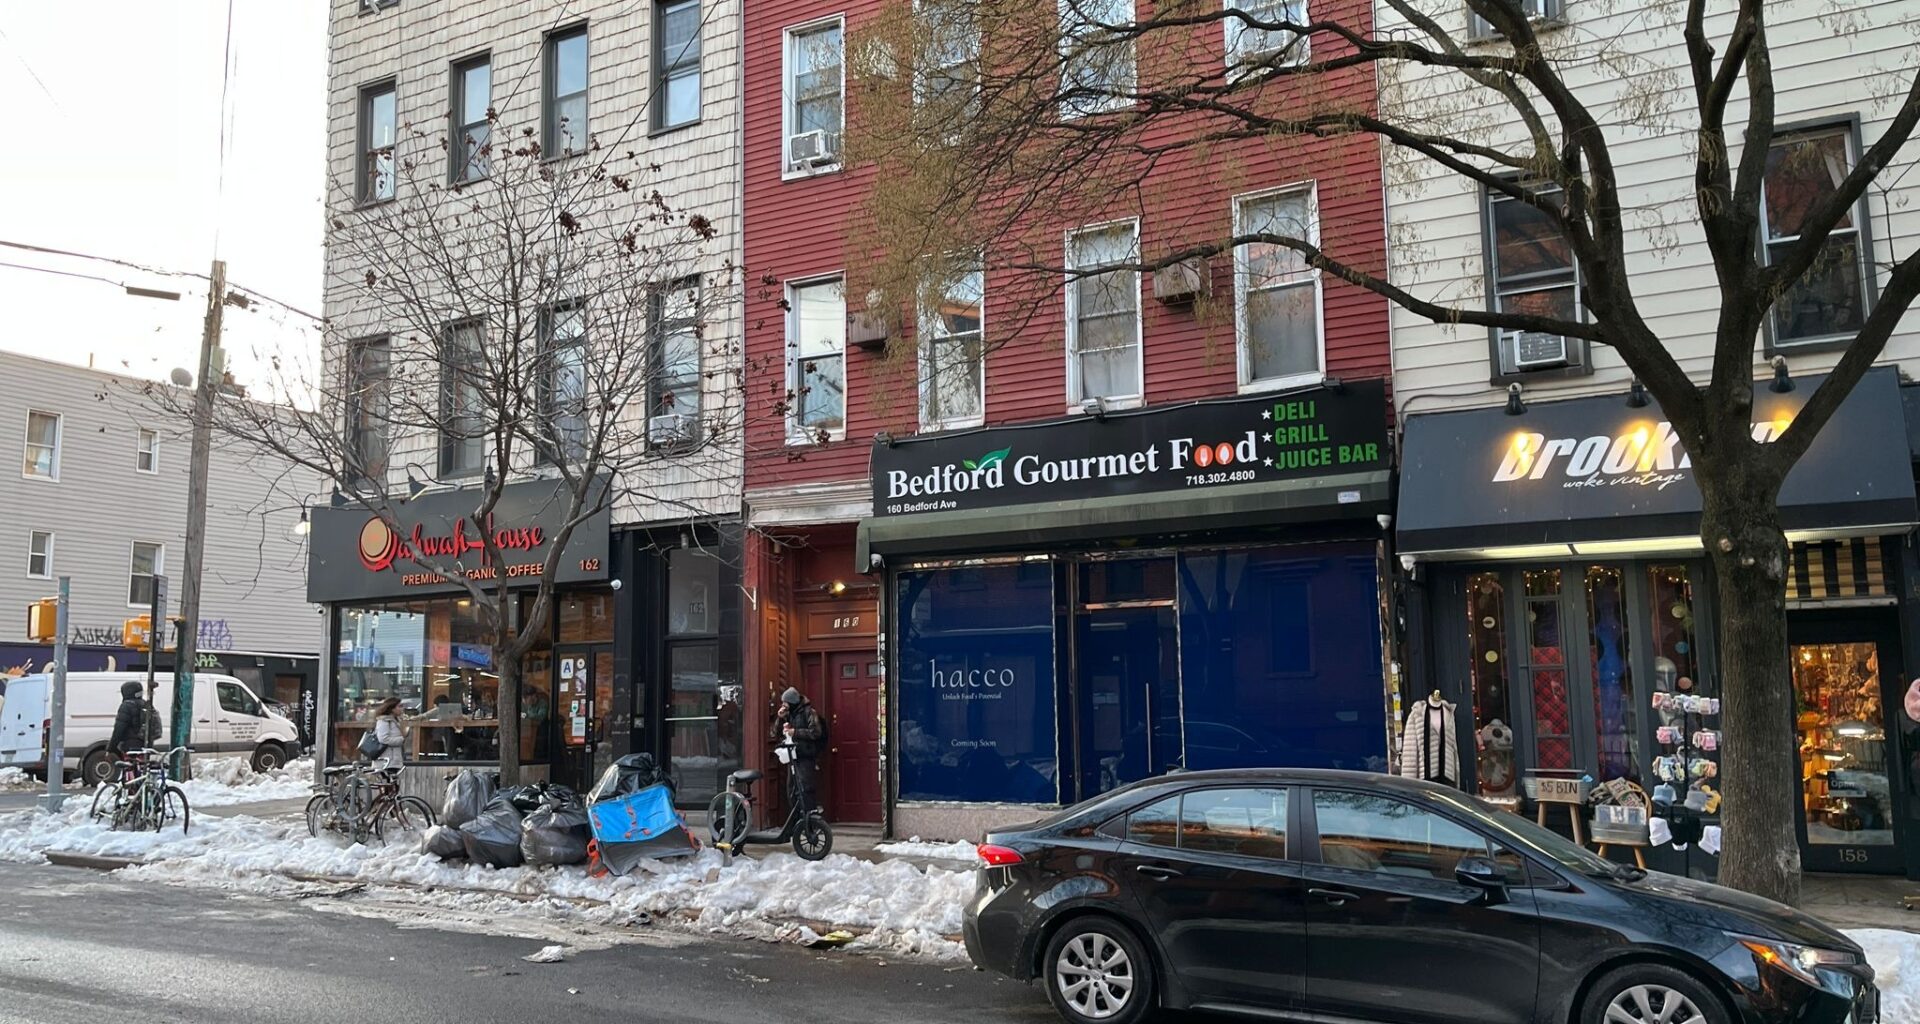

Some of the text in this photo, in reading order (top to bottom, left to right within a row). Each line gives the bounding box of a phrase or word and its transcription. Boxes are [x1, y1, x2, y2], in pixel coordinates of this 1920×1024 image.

[1274, 401, 1315, 421] DELI
[1275, 424, 1328, 445] GRILL
[1275, 443, 1378, 469] JUICE BAR
[1492, 421, 1792, 482] Brookn
[887, 430, 1258, 498] Bedford Gourmet Food
[1186, 469, 1255, 486] 718.302.4800
[1563, 472, 1685, 491] woke vintage
[887, 500, 957, 514] 160 Bedford Ave
[505, 563, 544, 577] OFFEE
[579, 559, 599, 571] 162
[563, 662, 571, 673] A
[929, 658, 1014, 688] hacco
[951, 738, 997, 750] Coming Soon
[1541, 781, 1578, 794] $5 BIN
[1838, 849, 1868, 863] 158
